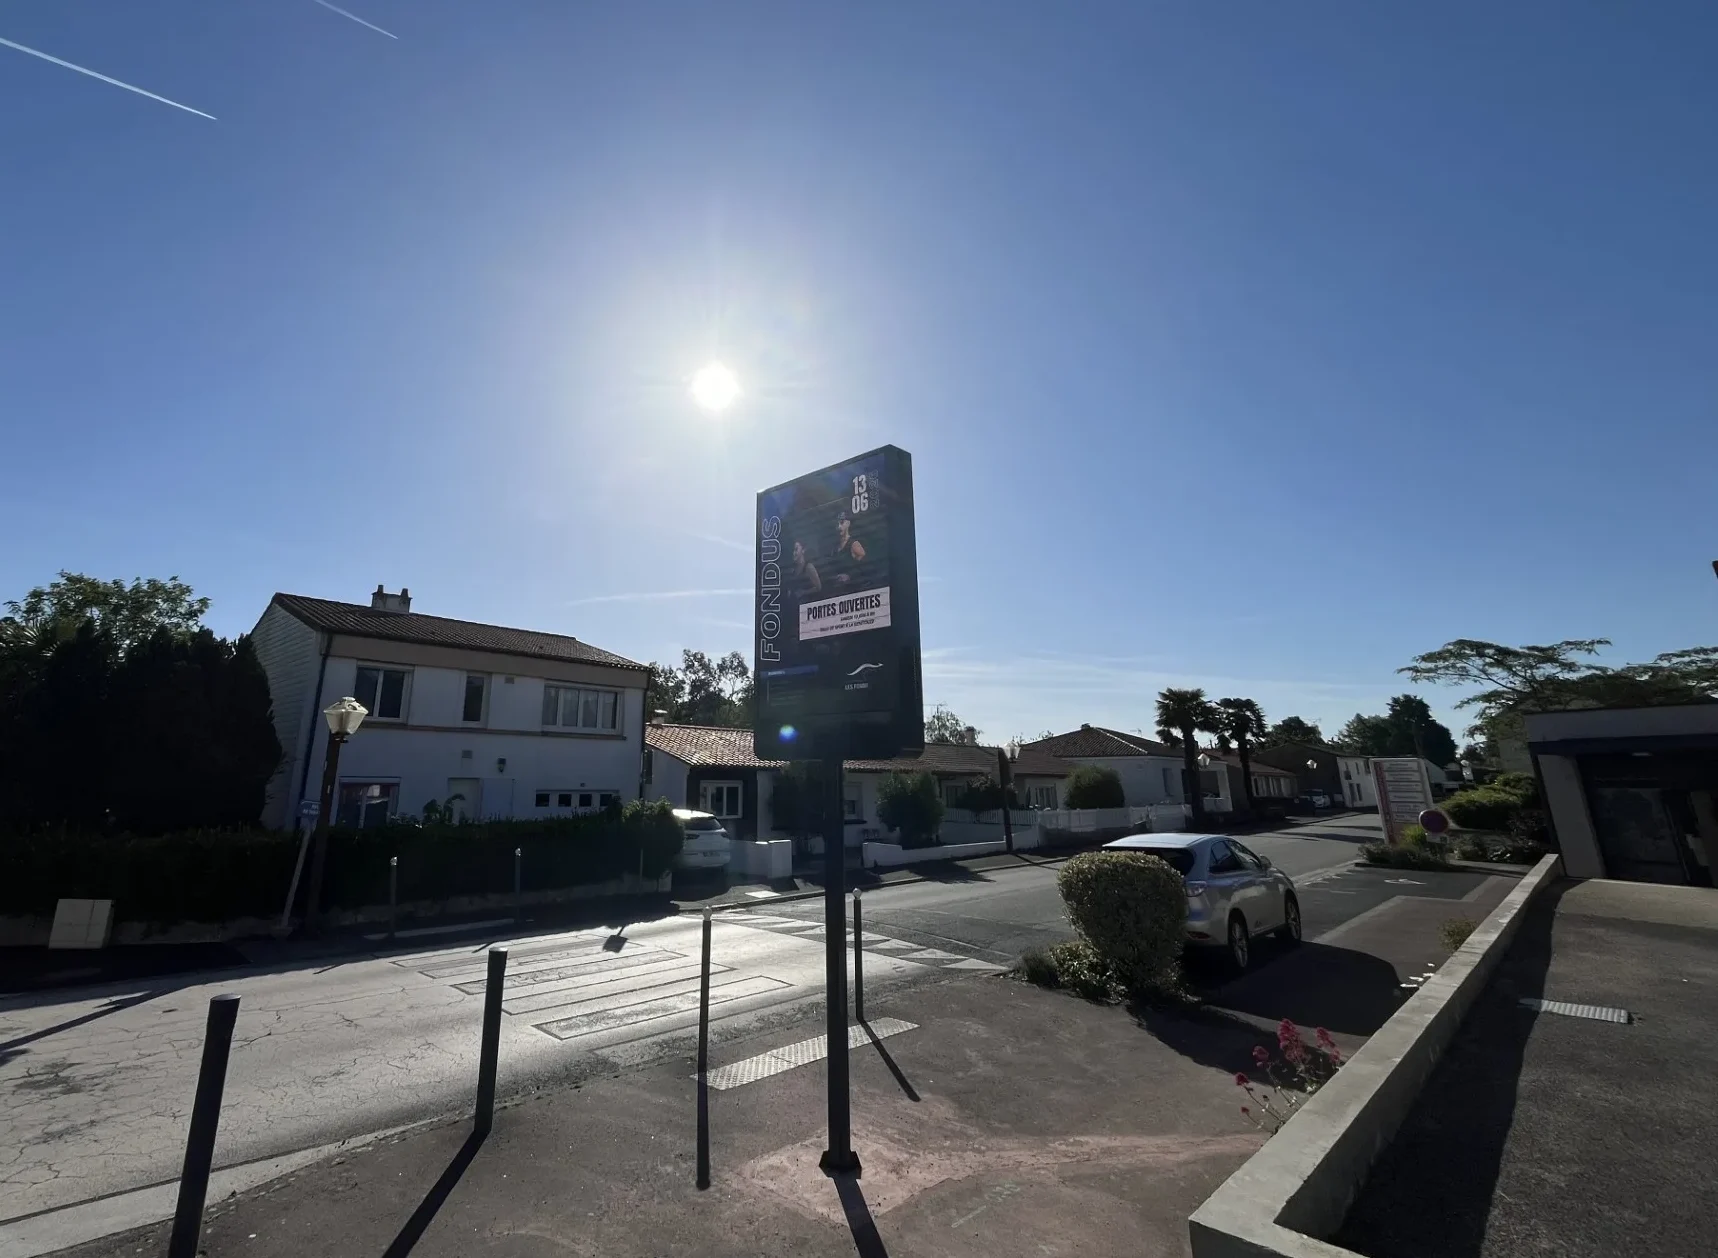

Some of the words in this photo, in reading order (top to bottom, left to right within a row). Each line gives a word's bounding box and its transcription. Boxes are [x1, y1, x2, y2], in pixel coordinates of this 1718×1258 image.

[852, 474, 867, 495] 13
[851, 492, 869, 514] 06
[761, 515, 781, 661] FONDUS
[807, 603, 837, 621] PORTES
[839, 594, 881, 614] OUVERTES
